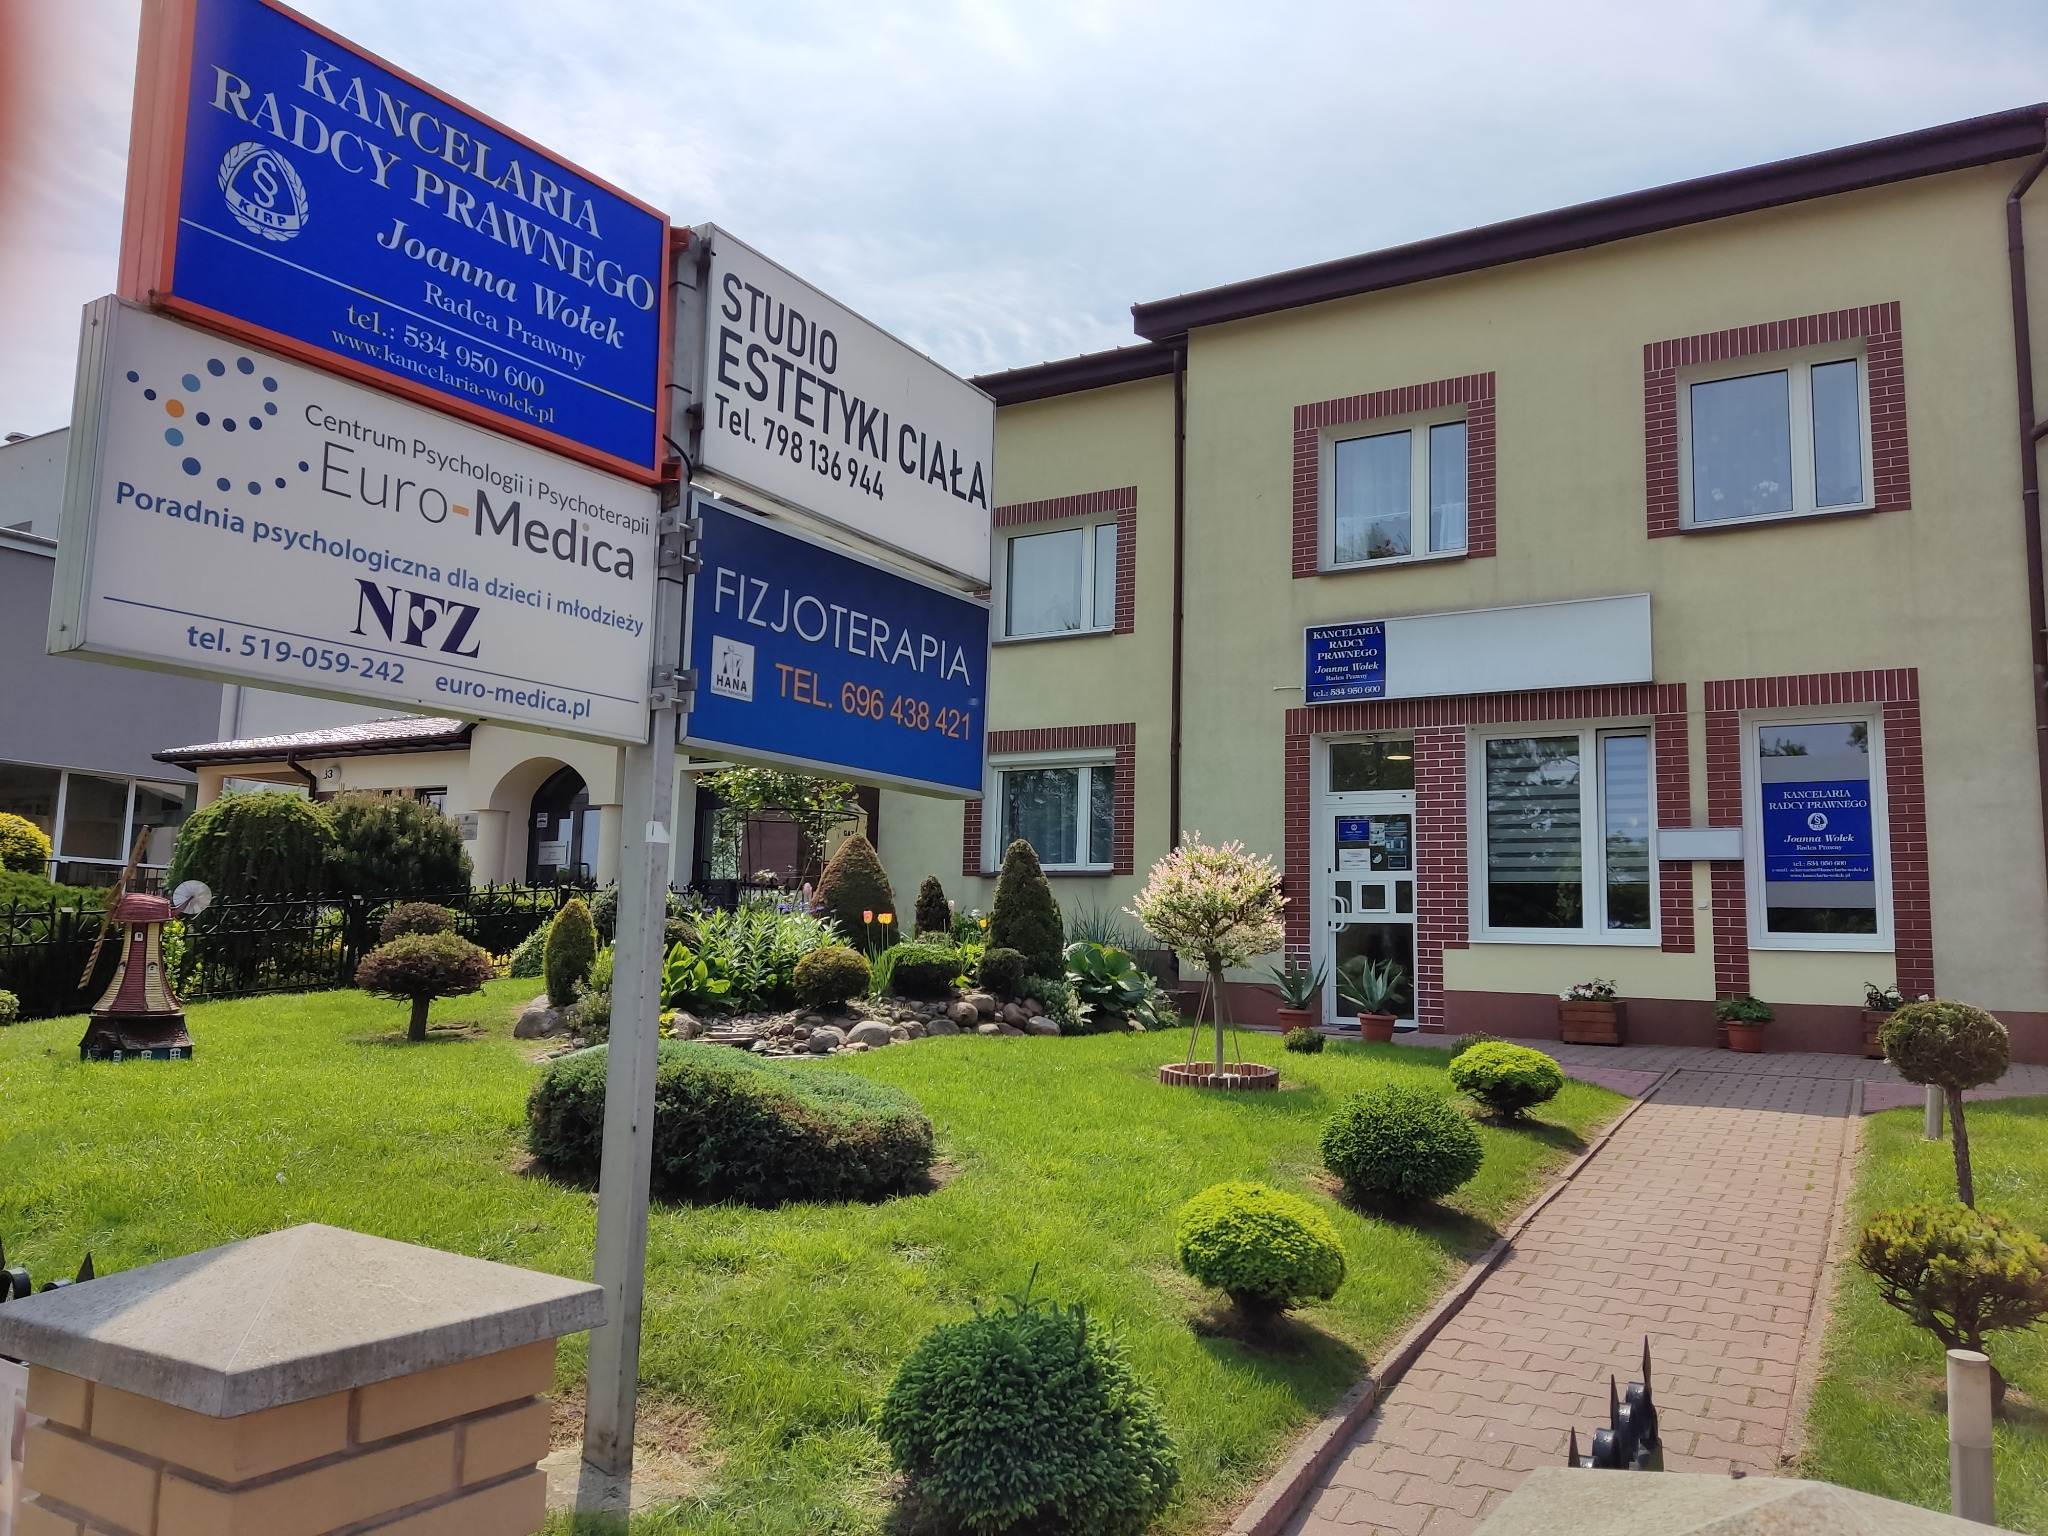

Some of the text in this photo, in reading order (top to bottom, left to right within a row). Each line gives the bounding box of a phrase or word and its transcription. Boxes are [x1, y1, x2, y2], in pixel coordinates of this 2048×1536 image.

[298, 50, 603, 240] KANCELARIA
[208, 65, 655, 311] RADCY PRAWNEGO
[238, 198, 287, 227] KIRP
[376, 218, 518, 303] Joanna
[347, 304, 545, 397] tel.: 534 950 600
[423, 281, 586, 371] Radca Prawny
[720, 272, 838, 375] STUDIO
[714, 392, 885, 501] Tel. 798 136 944
[716, 325, 988, 510] ESTETYKI CIAŁA
[304, 405, 650, 536] Centrum Psychologii i Psychoterapii
[320, 441, 636, 580] Euro-Medica
[115, 482, 644, 638] Poradnia psychologiczna dla dzieci i młodzieży
[187, 625, 405, 684] tel. 519-059-242
[350, 578, 482, 659] NFZ
[713, 566, 972, 686] FIZJOTERAPIA
[1313, 626, 1381, 640] KANCELARIA
[1317, 648, 1378, 660] PRAWNEGO
[1329, 639, 1365, 649] RADCY
[434, 673, 592, 719] euro-medica.pl
[717, 674, 747, 692] HANA
[775, 662, 970, 741] TEL. 696 438 421
[1314, 665, 1349, 674] Joanna
[1347, 686, 1363, 695] 950
[1364, 685, 1381, 694] 600
[1768, 800, 1867, 810] RADCY PRAWNEGO
[1783, 789, 1851, 799] KANCELARIA
[1783, 834, 1822, 843] Joanna
